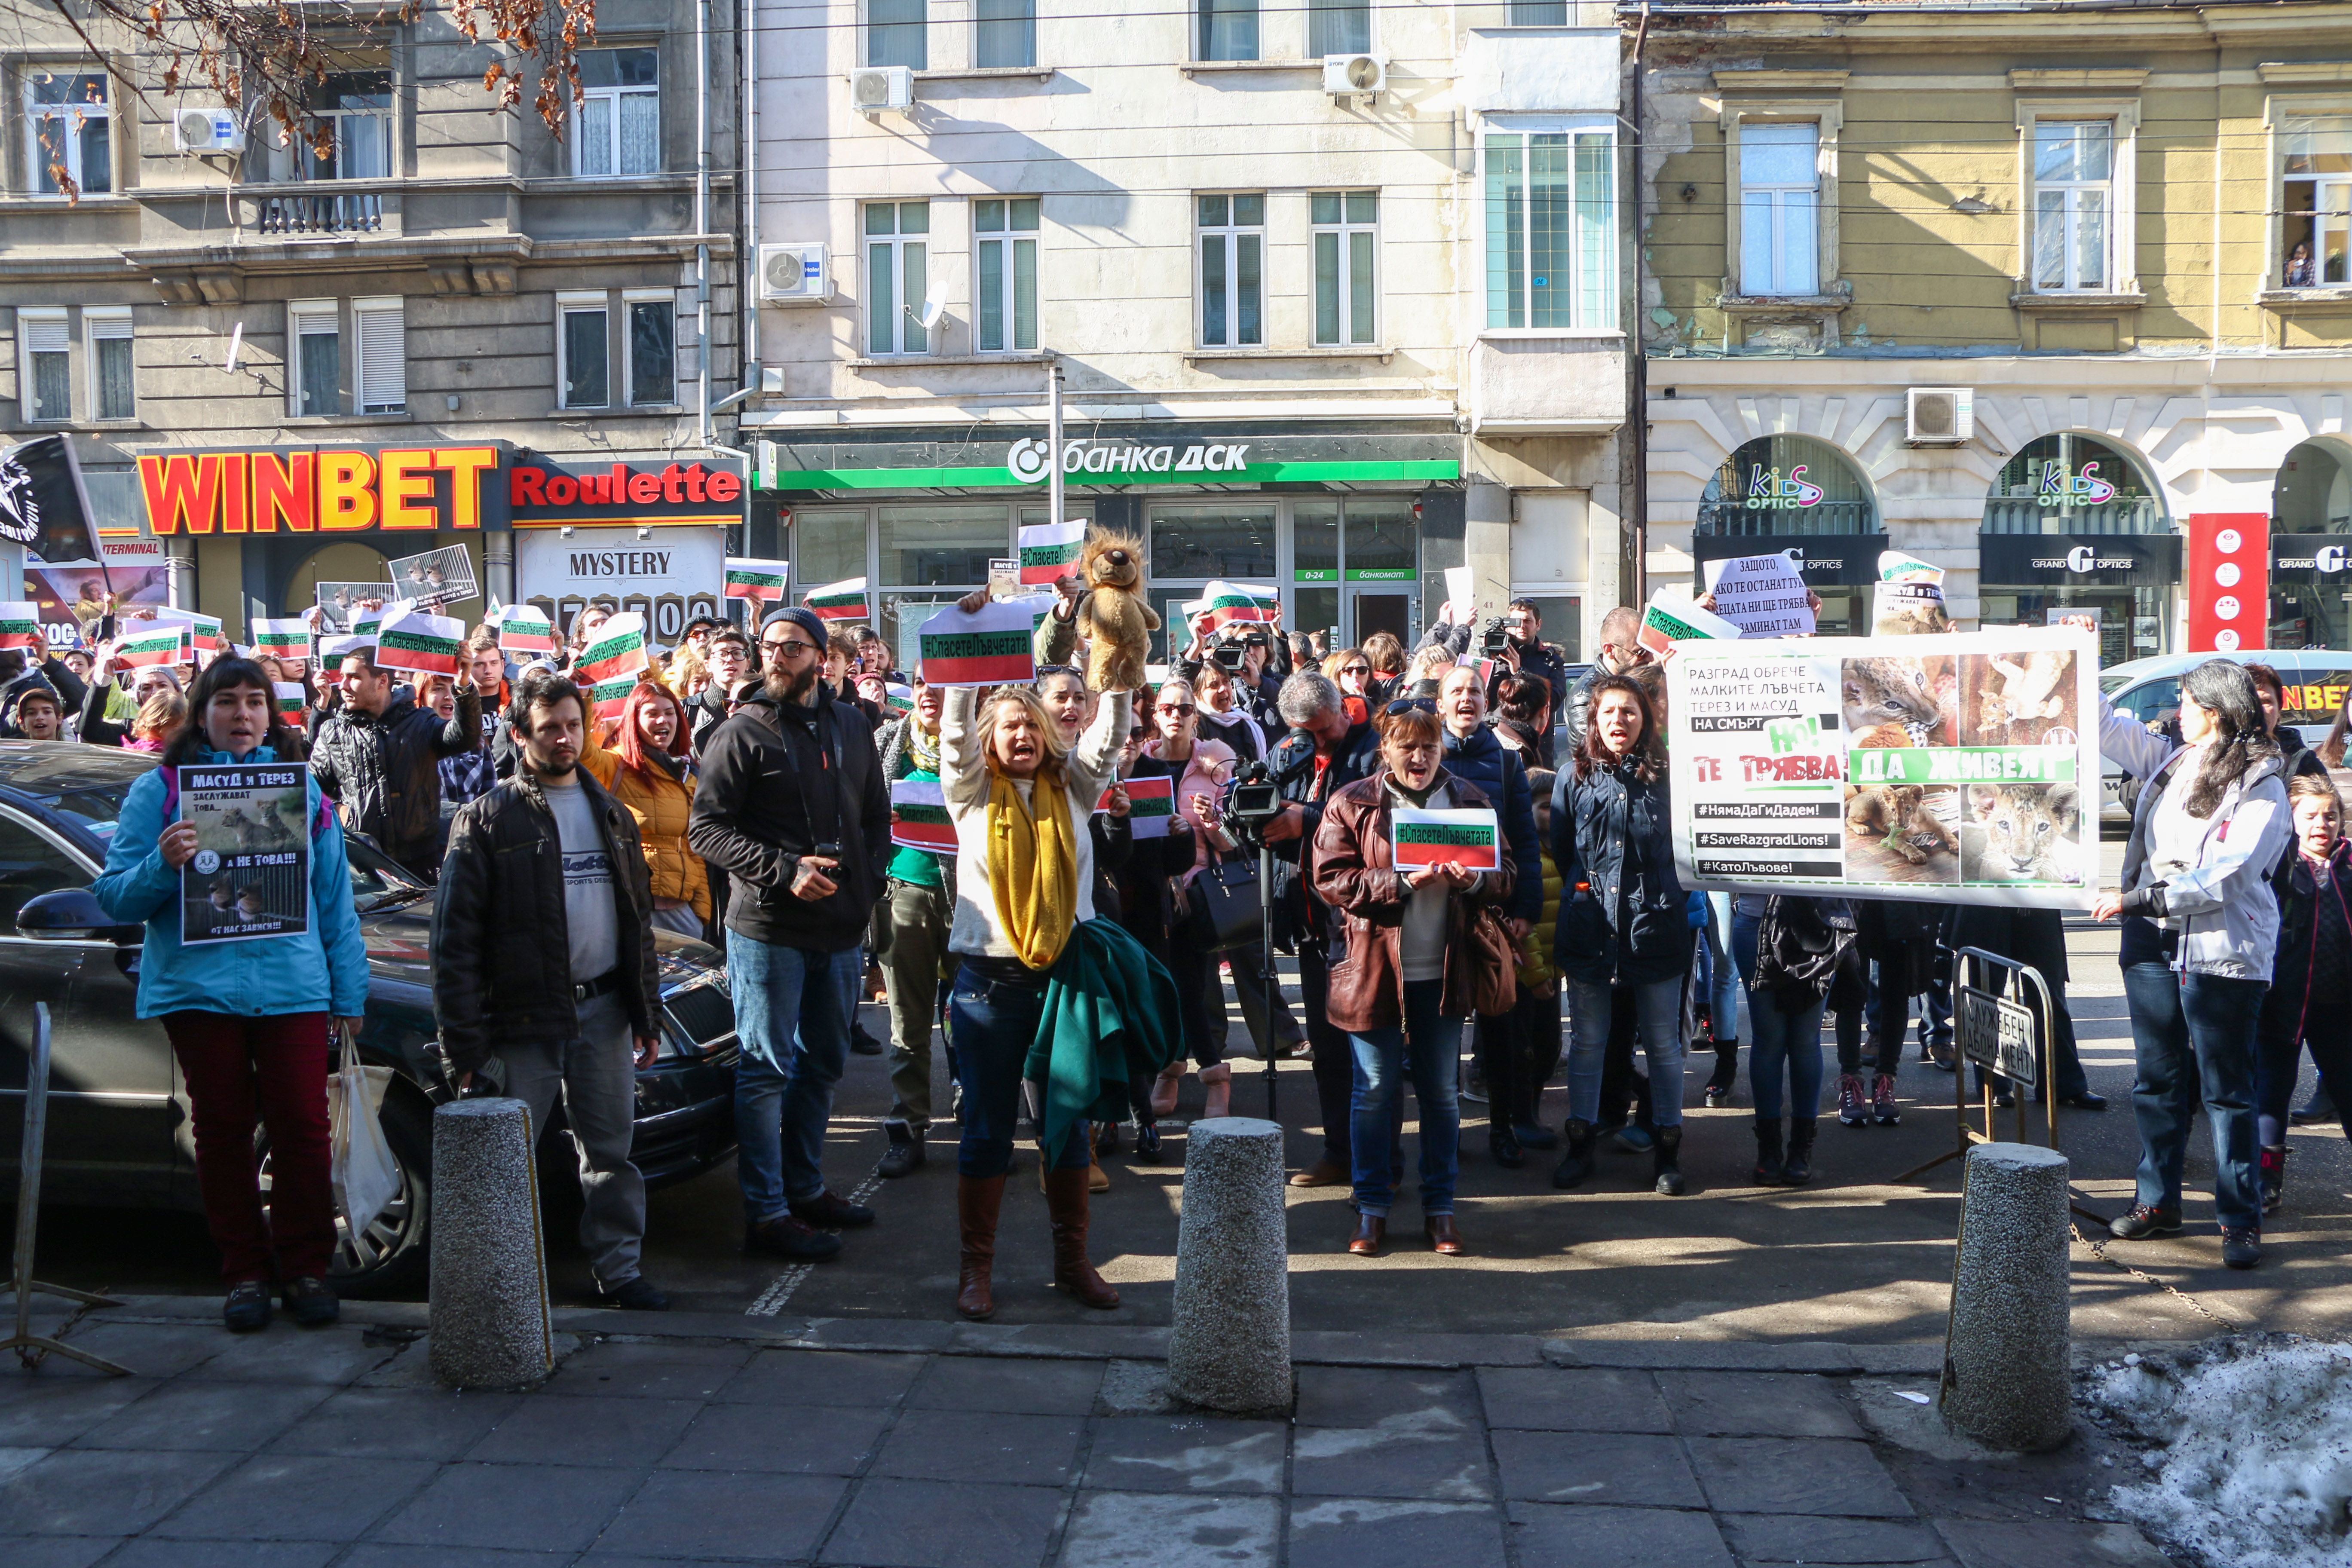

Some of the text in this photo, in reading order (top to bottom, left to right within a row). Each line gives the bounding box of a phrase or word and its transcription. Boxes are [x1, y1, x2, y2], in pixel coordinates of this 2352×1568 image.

[1063, 440, 1250, 473] банка ДСК
[136, 447, 498, 534] WINBET
[511, 463, 741, 506] Roulette
[570, 552, 671, 576] MYSTERY
[1740, 559, 1779, 573] ЗАЩОТО,
[2067, 546, 2095, 573] G
[2279, 546, 2346, 573] GRAND G
[728, 572, 782, 588] #СпасетеЛъвчетата
[1359, 570, 1404, 579] банкомат
[1715, 582, 1733, 595] АКО
[1735, 582, 1746, 593] ТЕ
[1747, 579, 1786, 592] ОСТАНАТ
[1926, 587, 1945, 600] ТЕРЕ
[1748, 601, 1761, 612] НИ
[1763, 600, 1777, 612] ЩЕ
[1778, 596, 1811, 609] ТРЯБВА
[504, 621, 551, 636] #СпасетеЛъвчетата
[1740, 618, 1802, 634] ЗАМИНАТ ТАМ
[258, 634, 307, 645] #СпасетеЛъвчетата
[383, 631, 458, 655] #СпасетеЛъвчетата
[925, 634, 1027, 658] #СпасетеЛъвчетата
[1690, 666, 1806, 680] РАЗГРАД ОБРЕЧЕ
[1690, 682, 1825, 696] МАЛКИТЕ ЛЪВЧЕТА
[1691, 700, 1798, 713] ТЕРЕЗ И МАСУД
[1695, 717, 1763, 730] НА СМЪРТ
[1769, 717, 1819, 753] НО!
[1694, 750, 2057, 782] ТЕ ТРЯБВА ДА ЖИВЕЯТ
[193, 773, 242, 787] МАСУД
[258, 772, 295, 785] ТЕРЕЗ
[193, 791, 251, 801] ЗАСЛУЖАВАТ
[1699, 804, 1819, 817] #НямаДаГиДадем!
[1400, 824, 1491, 845] #СпасетеЛъвчетата
[1700, 834, 1828, 848] #SaveRazgradLions!
[237, 856, 251, 867] НЕ
[562, 855, 611, 872] lott
[1703, 861, 1793, 873] #КатоЛъвове!
[223, 924, 239, 934] НАС
[241, 922, 281, 932] ЗАВИСИ!!!
[1969, 1000, 2025, 1043] СЛУЖЕБЕН
[1967, 1027, 2031, 1075] АБОНАМЕНТ
